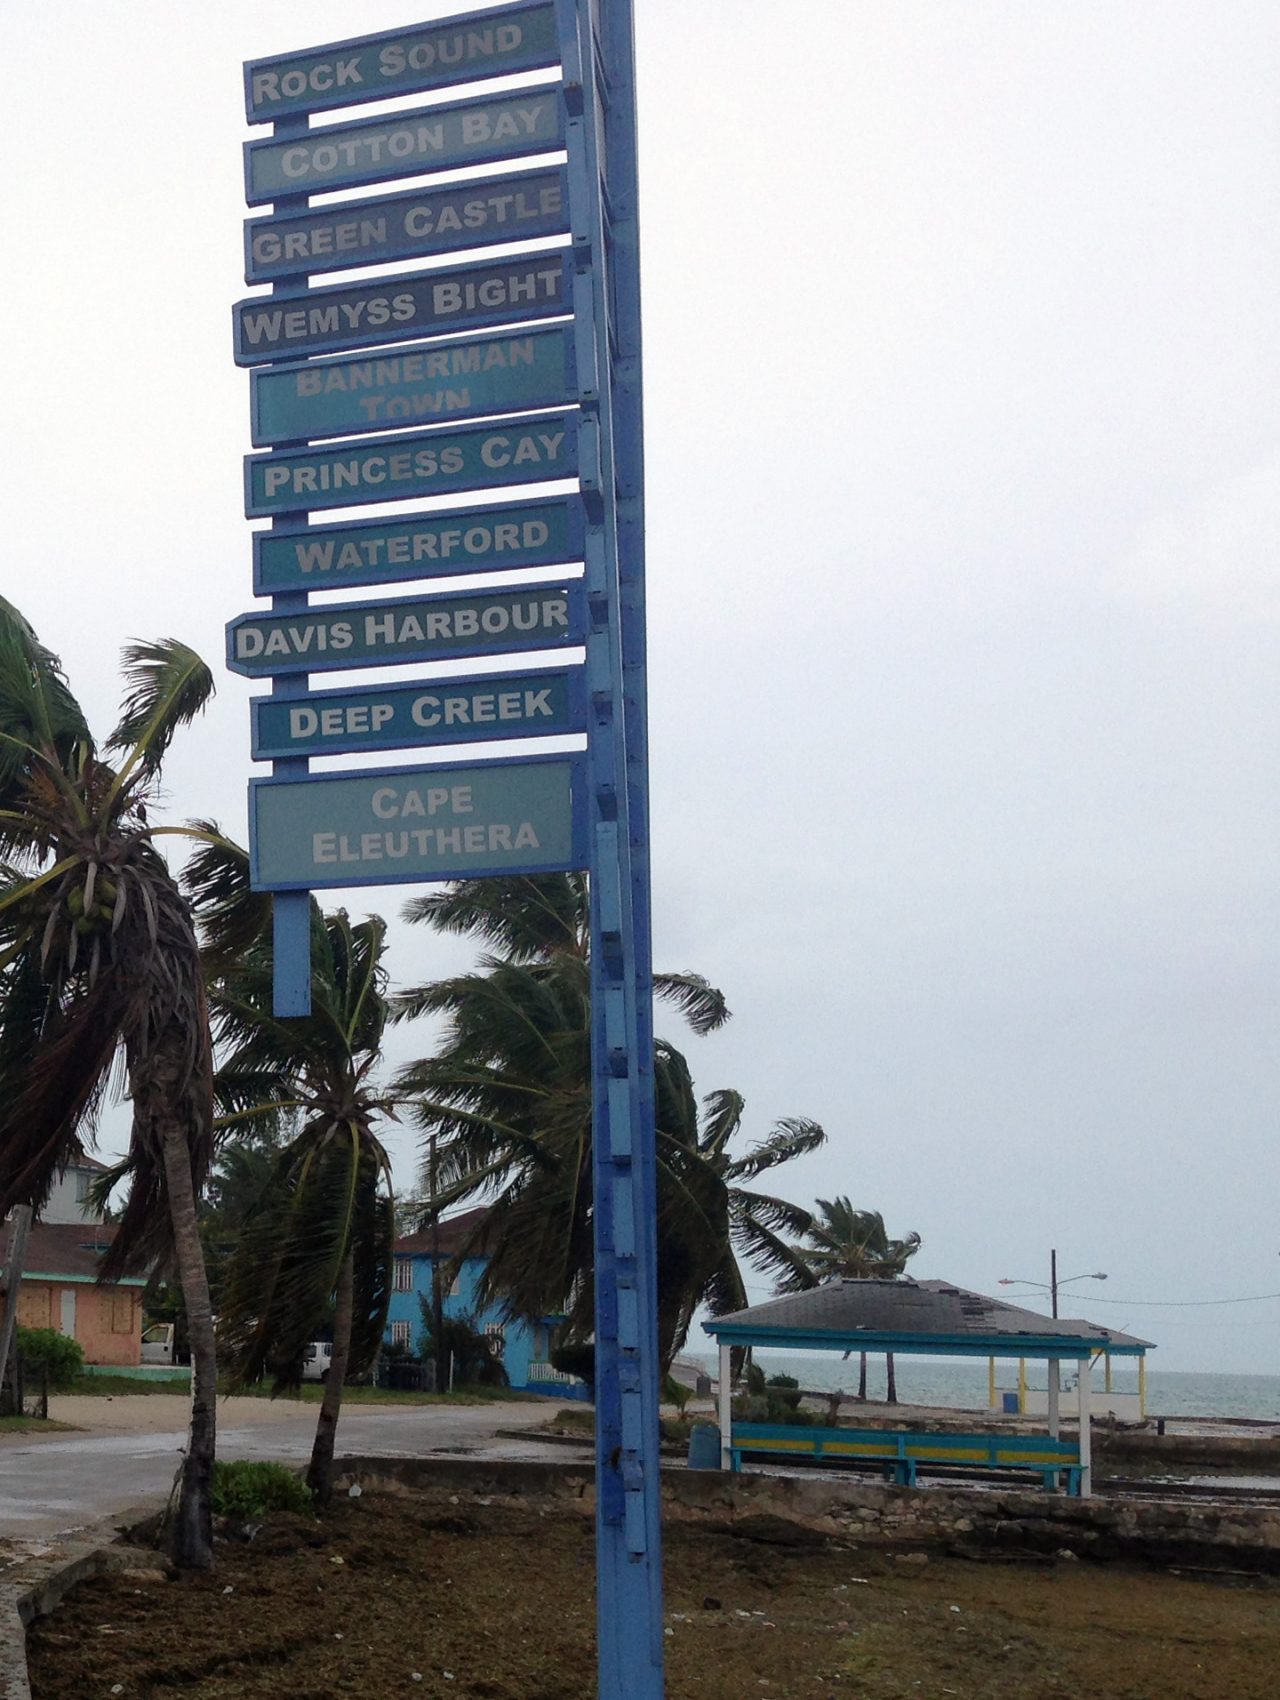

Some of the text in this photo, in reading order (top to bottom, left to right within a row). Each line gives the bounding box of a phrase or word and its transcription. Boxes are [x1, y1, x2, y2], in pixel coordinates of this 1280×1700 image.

[253, 25, 521, 103] ROCK SOUND
[281, 108, 541, 177] COTTON BAY
[253, 188, 561, 263] GREEN CASTLE
[243, 269, 563, 345] WEMYSS BIGHT
[297, 340, 534, 396] BANNERMAN
[360, 388, 471, 419] TOWN
[264, 432, 565, 497] PRINCESS CAY
[296, 521, 549, 573] WATERFORD
[237, 600, 568, 658] DAVIS HARBOUR
[290, 689, 553, 738] DEEP CREEK
[371, 786, 473, 819] CAPE
[312, 822, 540, 863] ELEUTHERA
